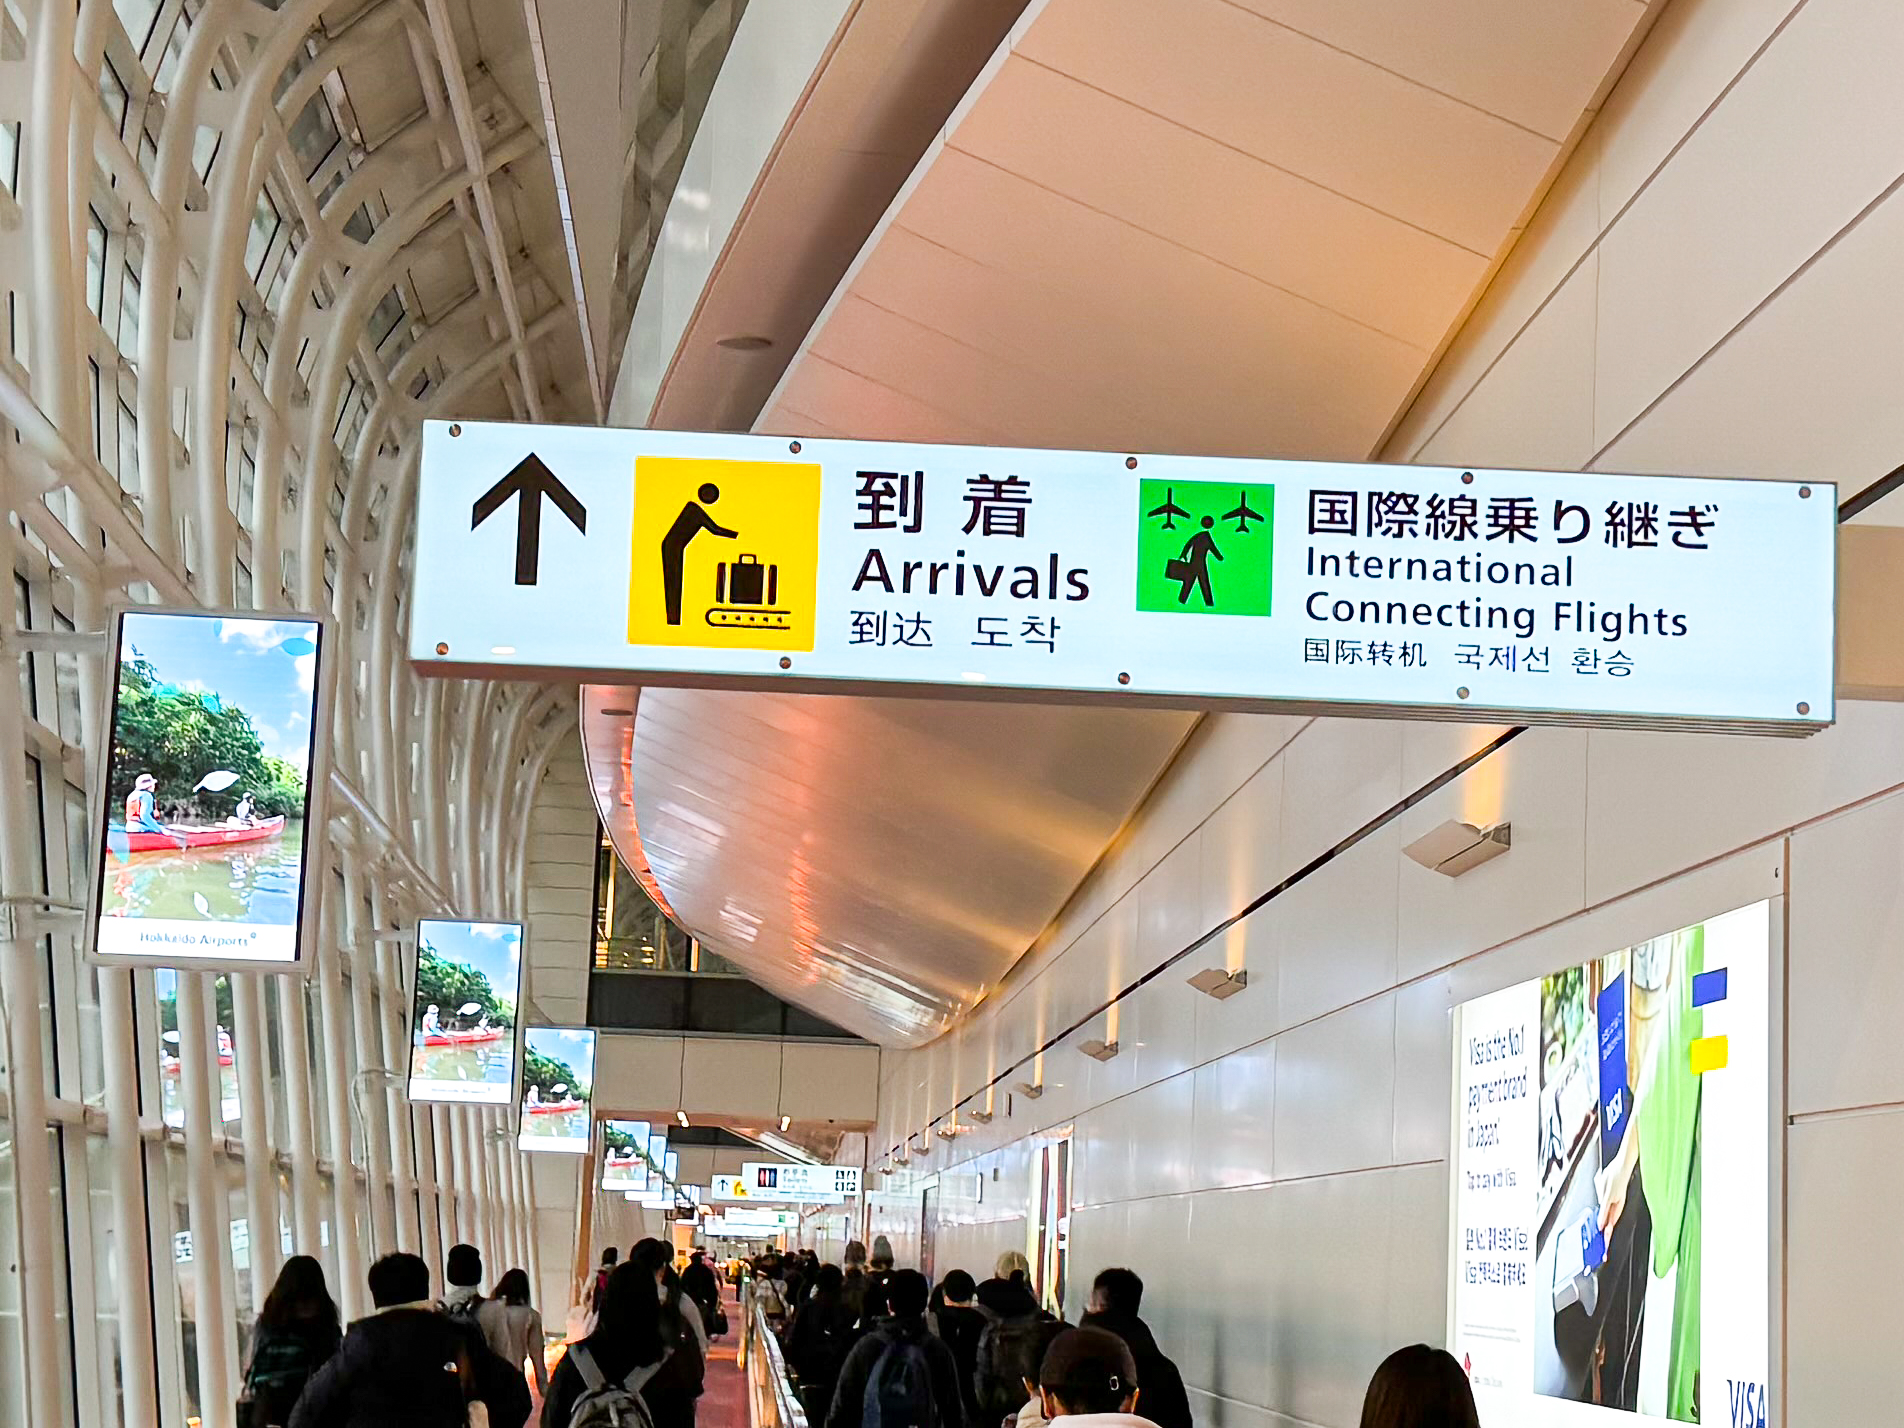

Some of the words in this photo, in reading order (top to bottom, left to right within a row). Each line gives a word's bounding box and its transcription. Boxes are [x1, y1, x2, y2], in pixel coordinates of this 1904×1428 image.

[853, 470, 1033, 538] 到着
[1307, 488, 1719, 551] 国際線乗り継ぎ
[851, 548, 1090, 602] Arrivals
[1307, 546, 1574, 588] International
[848, 609, 933, 647] 到达
[970, 615, 1061, 654] 도착
[1305, 591, 1536, 639] Connecting
[1554, 600, 1688, 643] Flights
[1304, 637, 1427, 669] 国际转机
[1454, 642, 1550, 674] 국제선
[1571, 646, 1635, 678] 환승
